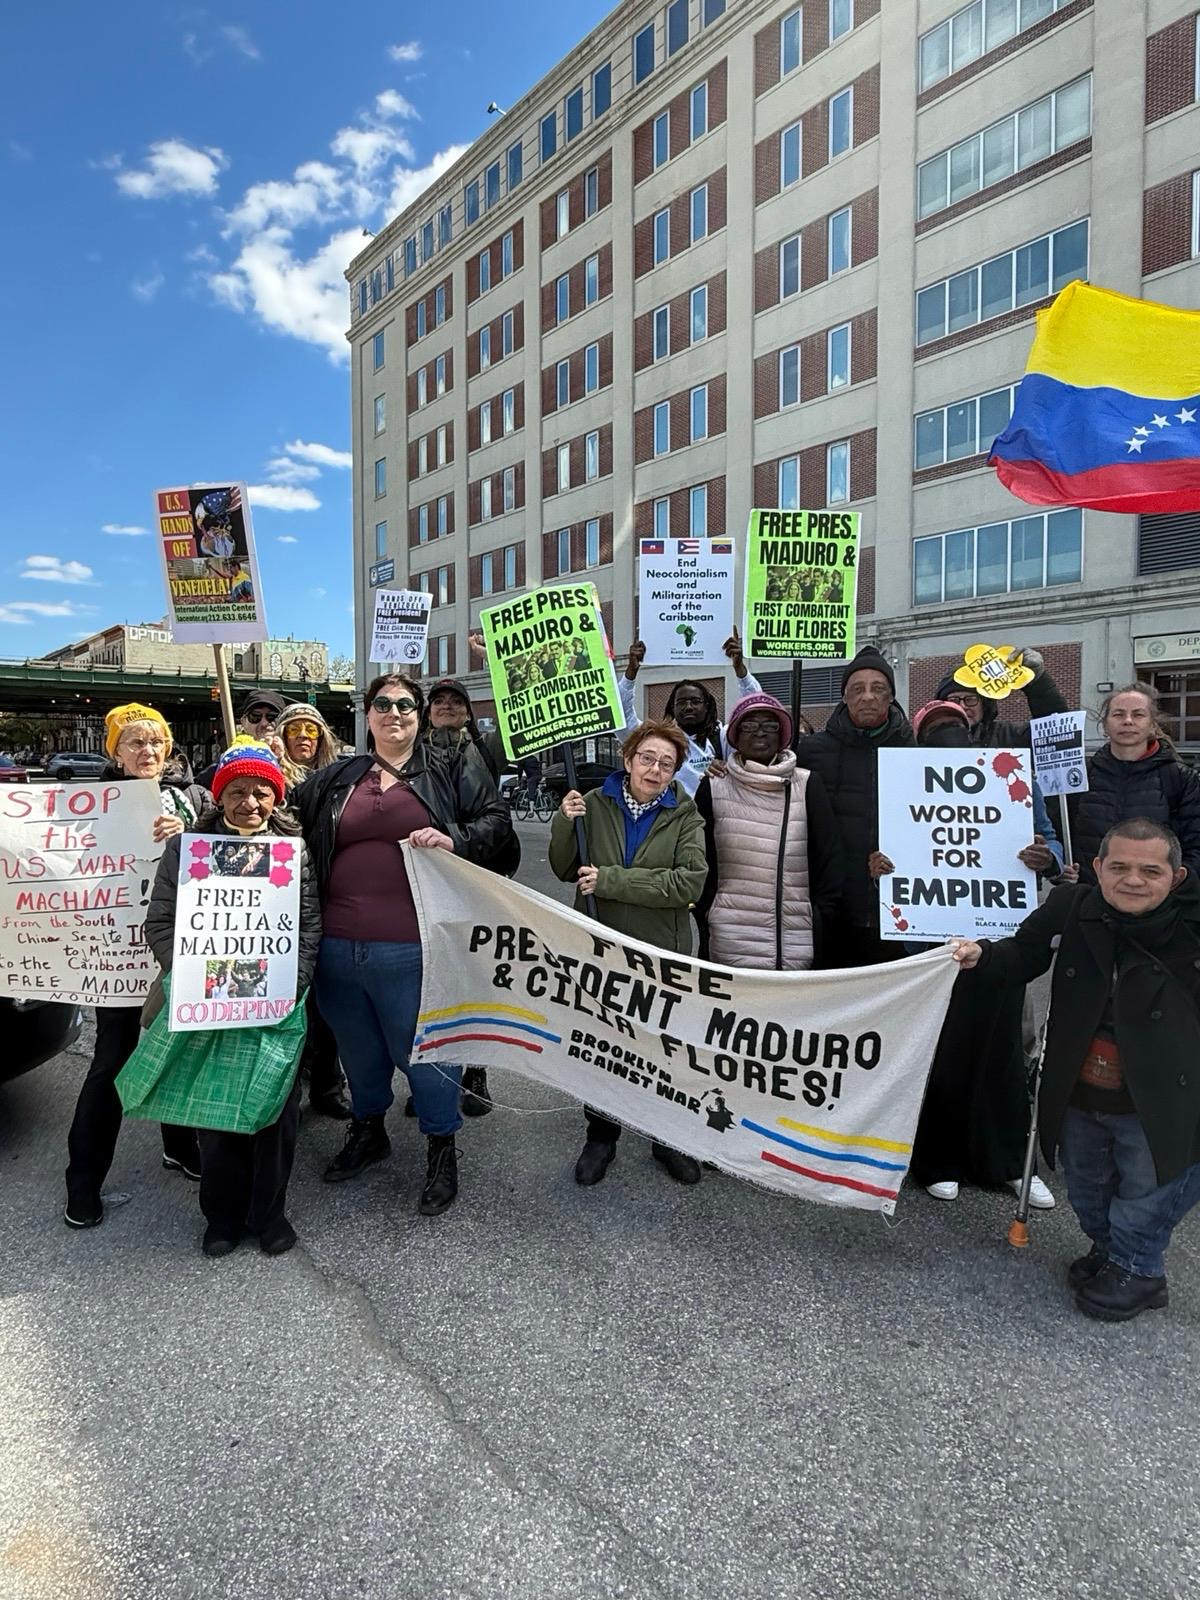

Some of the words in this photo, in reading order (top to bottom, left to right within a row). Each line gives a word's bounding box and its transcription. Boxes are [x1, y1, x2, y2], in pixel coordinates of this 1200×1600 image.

[165, 494, 184, 510] U.S.
[162, 518, 193, 534] HANDS
[758, 512, 802, 538] FREE
[807, 514, 857, 539] PRES.
[172, 541, 191, 557] OFF
[760, 540, 837, 567] MADURO
[843, 546, 856, 567] &
[677, 558, 697, 567] End
[646, 569, 728, 579] Neocolonialism
[171, 578, 231, 597] VENEZUELA!
[676, 580, 697, 589] and
[651, 590, 722, 600] Militarization
[209, 605, 230, 613] Action
[231, 604, 256, 612] Center
[490, 598, 534, 634] FREE
[535, 589, 595, 615] PRES.
[671, 601, 683, 611] of
[685, 601, 702, 611] the
[754, 603, 782, 617] FIRST
[786, 603, 850, 619] COMBATANT
[659, 612, 714, 622] Caribbean
[495, 615, 574, 660] MADURO
[579, 613, 596, 633] &
[756, 619, 791, 638] CILIA
[795, 619, 847, 639] FLORES
[766, 642, 835, 651] WORKERS.ORG
[792, 650, 817, 658] WORLD
[968, 649, 998, 673] FREE
[978, 658, 1011, 683] CILIA
[501, 690, 530, 713] FIRST
[533, 668, 605, 701] COMBATANT
[508, 705, 546, 733] CILIA
[548, 687, 608, 719] FLORES
[523, 712, 599, 742] WORKERS.ORG
[1060, 717, 1074, 725] OFF
[517, 738, 553, 755] WORKERS
[554, 729, 581, 743] WORLD
[583, 720, 610, 733] PARTY
[924, 765, 986, 794] NO
[3, 786, 120, 818] STOP
[909, 805, 1002, 825] WORLD
[41, 827, 97, 849] the
[931, 827, 981, 846] CUP
[0, 856, 46, 880] US
[78, 854, 138, 875] WAR
[932, 849, 982, 868] FOR
[196, 888, 262, 907] FREE
[891, 877, 1028, 909] EMPIRE
[2, 916, 41, 929] from
[50, 916, 71, 928] the
[74, 913, 115, 928] South
[190, 912, 271, 931] CILIA
[277, 913, 294, 931] &
[17, 933, 61, 944] China
[71, 931, 99, 942] Sea
[108, 930, 122, 943] to
[179, 936, 292, 956] MADURO
[63, 945, 79, 957] to
[20, 954, 51, 970] the
[587, 930, 733, 1001] FREE
[8, 974, 61, 988] FREE
[492, 963, 514, 990] &
[526, 966, 637, 1040] CILIA
[660, 1033, 843, 1111] FLORES!
[704, 1007, 882, 1070] MADURO
[570, 1029, 672, 1084] BROOKLYN
[568, 1045, 653, 1089] AGAINST
[656, 1081, 702, 1114] WAR
